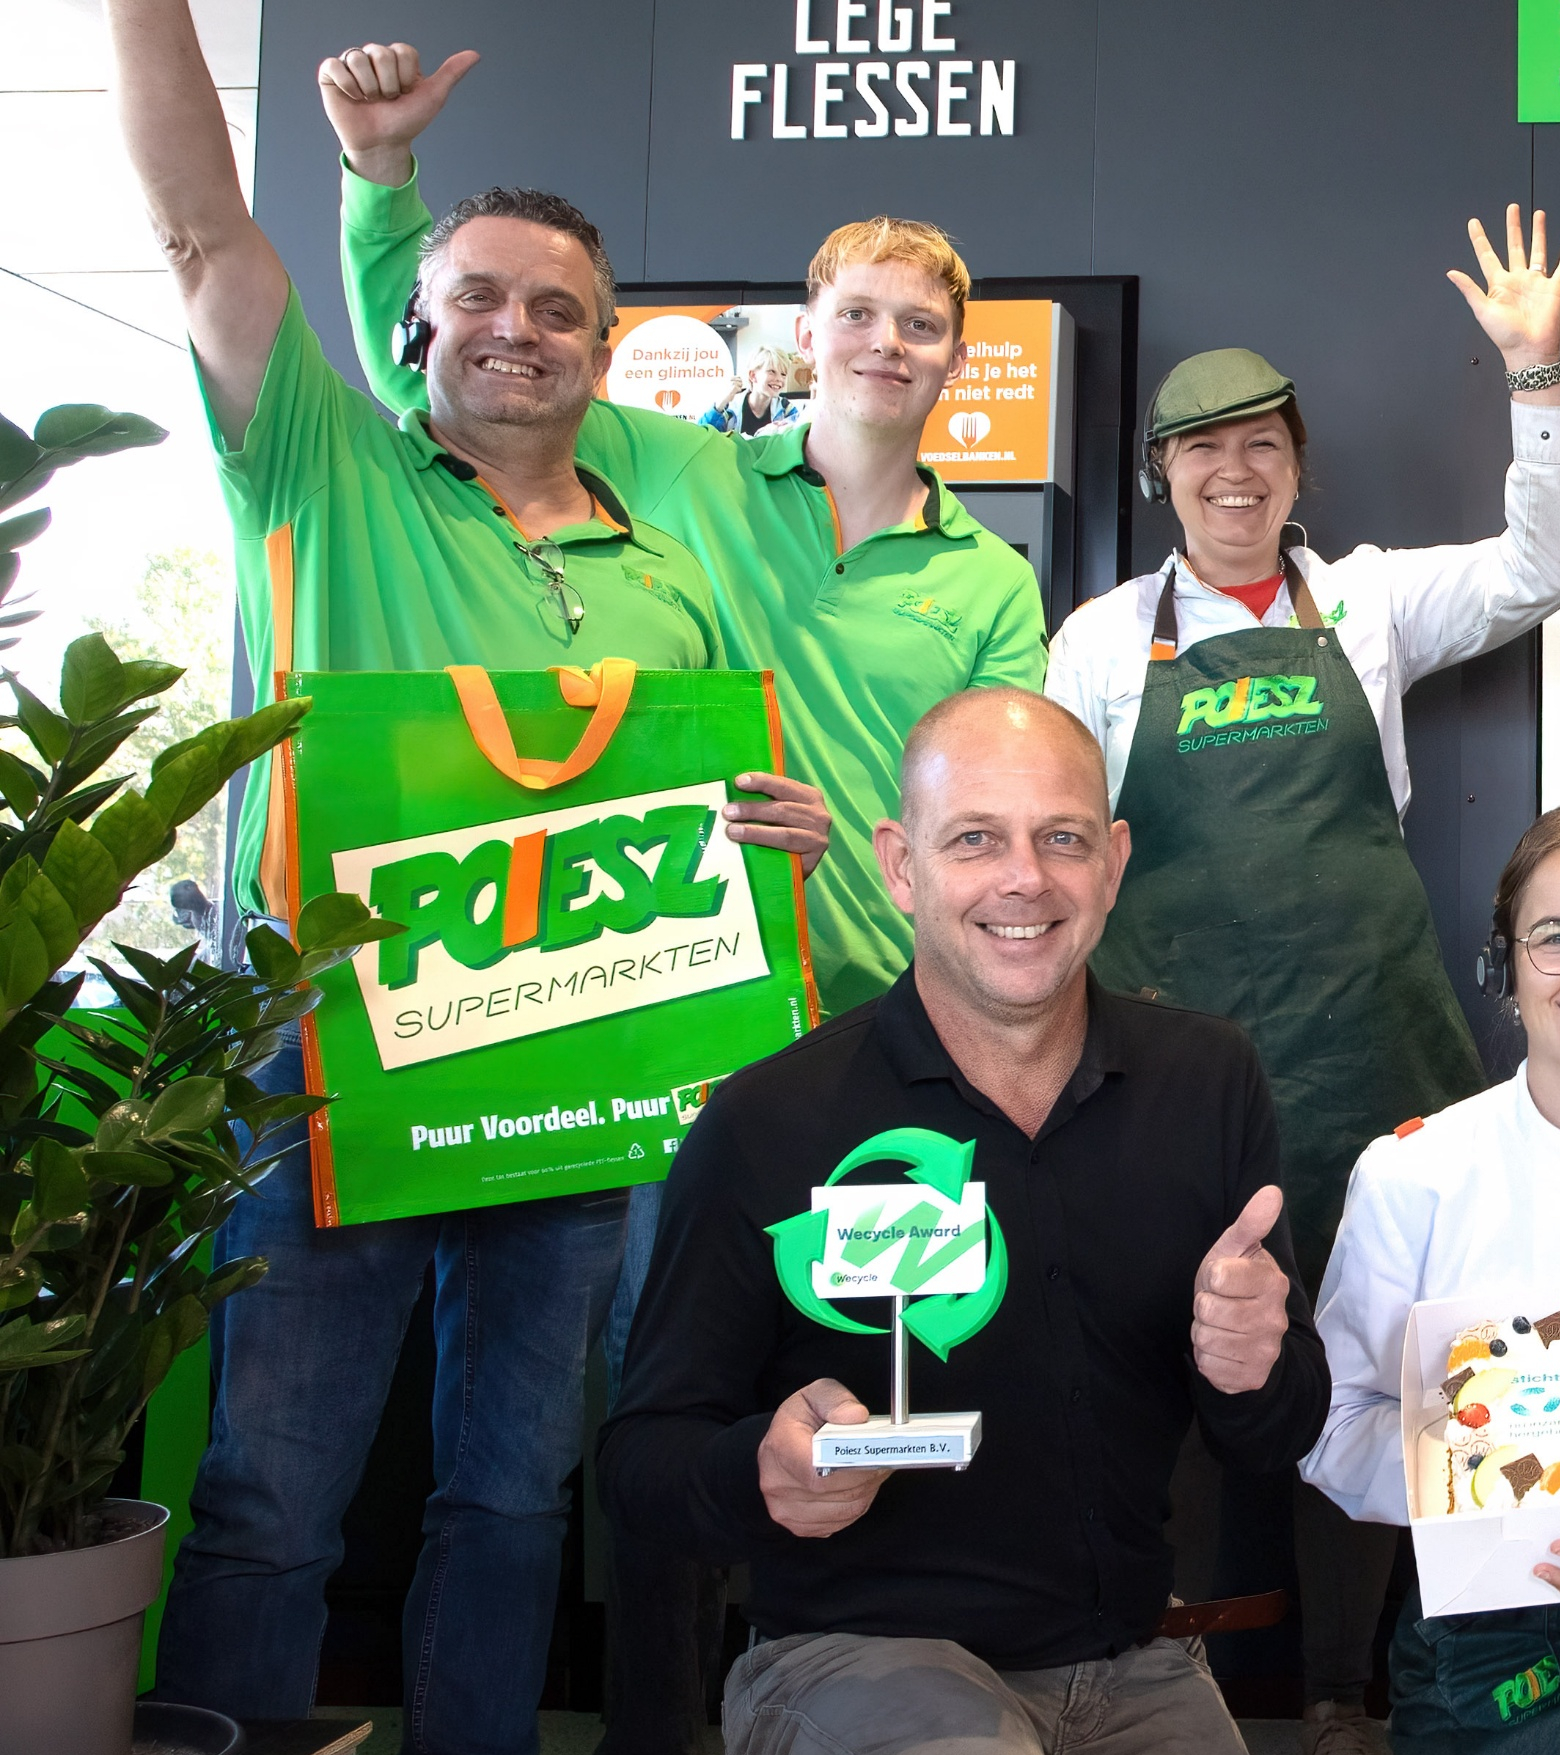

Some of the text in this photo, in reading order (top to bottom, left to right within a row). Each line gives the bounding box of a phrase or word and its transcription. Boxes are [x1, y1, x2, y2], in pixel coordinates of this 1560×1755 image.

[795, 0, 956, 54] LEGE
[730, 59, 1016, 140] FLESSEN
[633, 348, 719, 362] Dankzij jou
[966, 341, 1023, 360] elhulp
[625, 365, 725, 380] een glimlach
[983, 363, 1001, 382] je
[1006, 363, 1037, 379] het
[955, 385, 991, 401] niet
[995, 384, 1035, 400] redt
[920, 451, 1017, 463] VOEDSELBANKEN.NL
[1177, 674, 1324, 736] POIESZ
[1178, 718, 1330, 754] SUPERMARKTEN
[370, 804, 730, 991] POIESZ
[393, 931, 740, 1040] SUPERMARKTEN
[411, 1121, 475, 1151] Puur
[480, 1100, 606, 1141] Voordeel.
[611, 1096, 671, 1123] Puur
[837, 1225, 961, 1242] Wecycle Award
[837, 1274, 878, 1284] Wecycle
[835, 1443, 950, 1456] Poiesz Supermarkten B.V.
